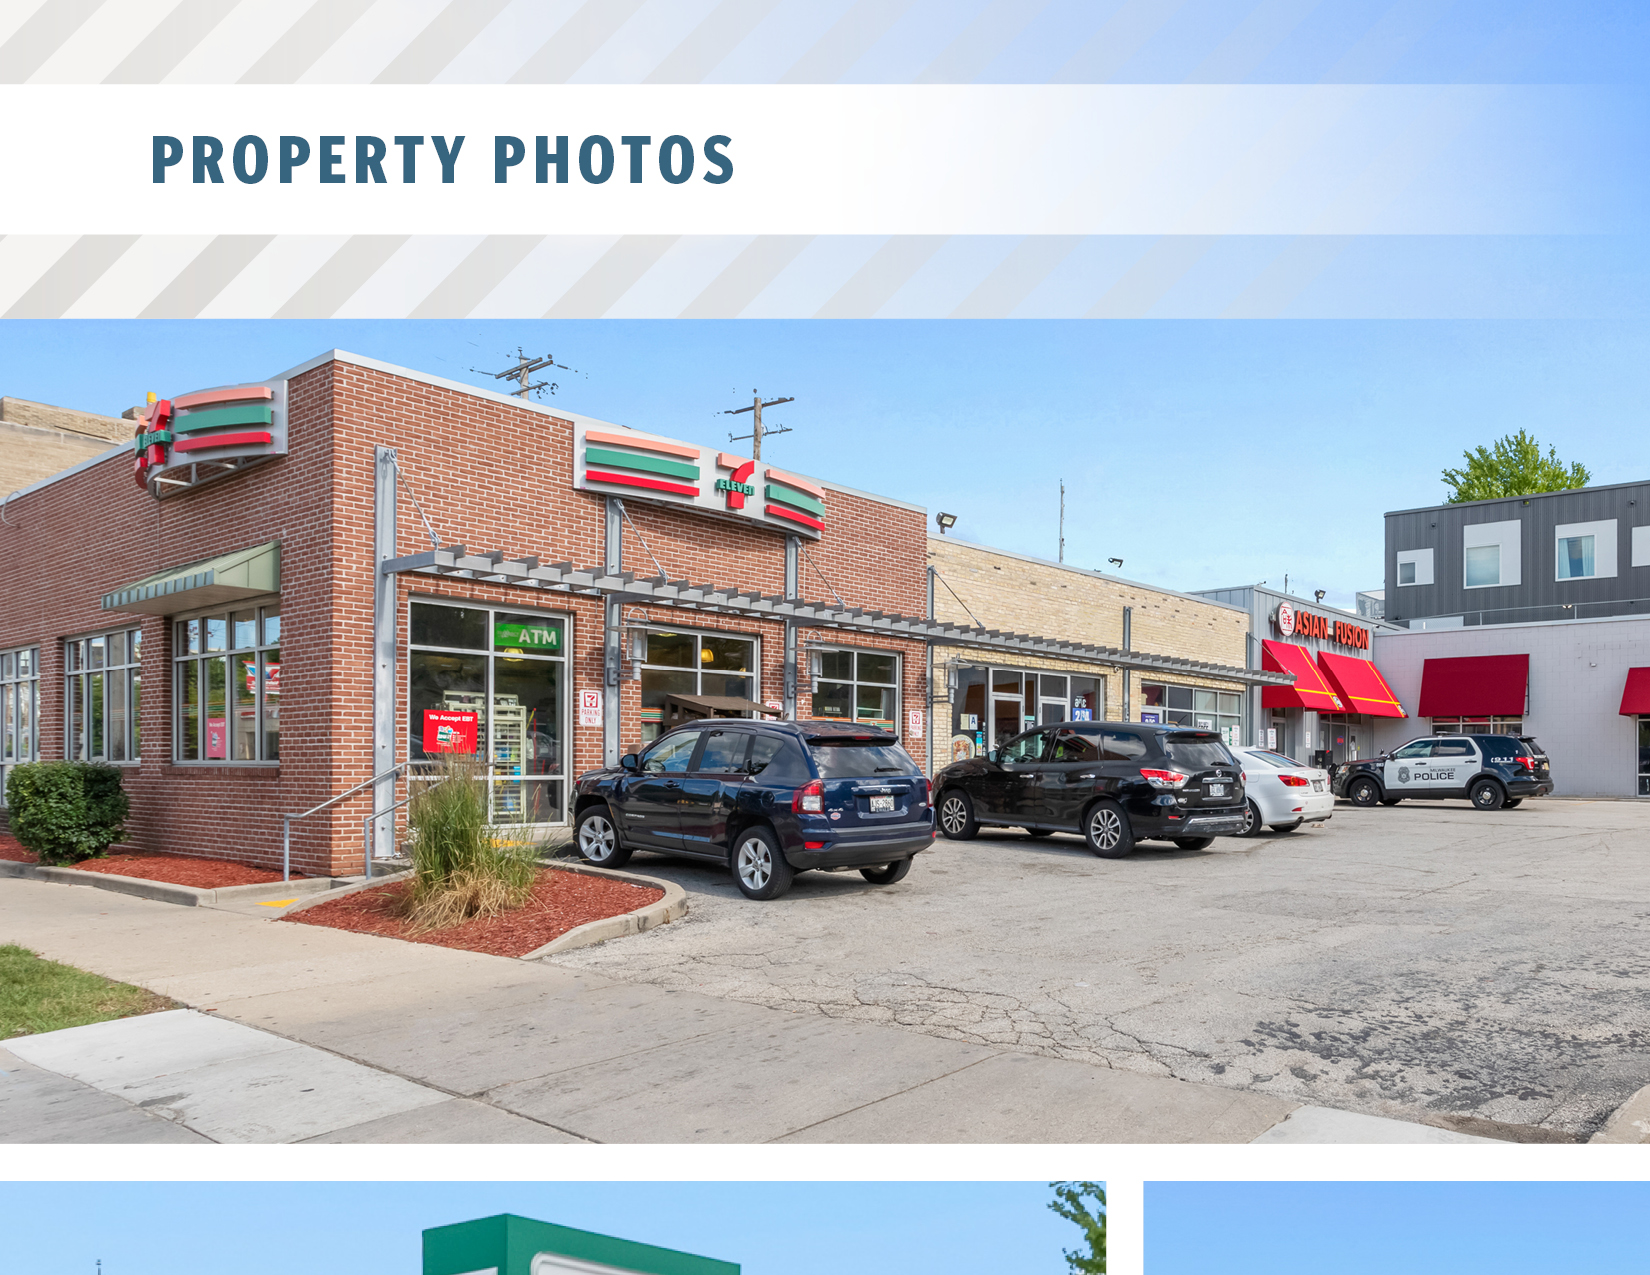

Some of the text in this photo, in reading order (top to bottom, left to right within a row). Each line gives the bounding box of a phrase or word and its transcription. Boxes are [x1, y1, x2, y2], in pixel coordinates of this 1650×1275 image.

[519, 629, 556, 645] ATM
[1295, 610, 1368, 649] ASIAN FUSION
[1414, 772, 1454, 780] POLICE
